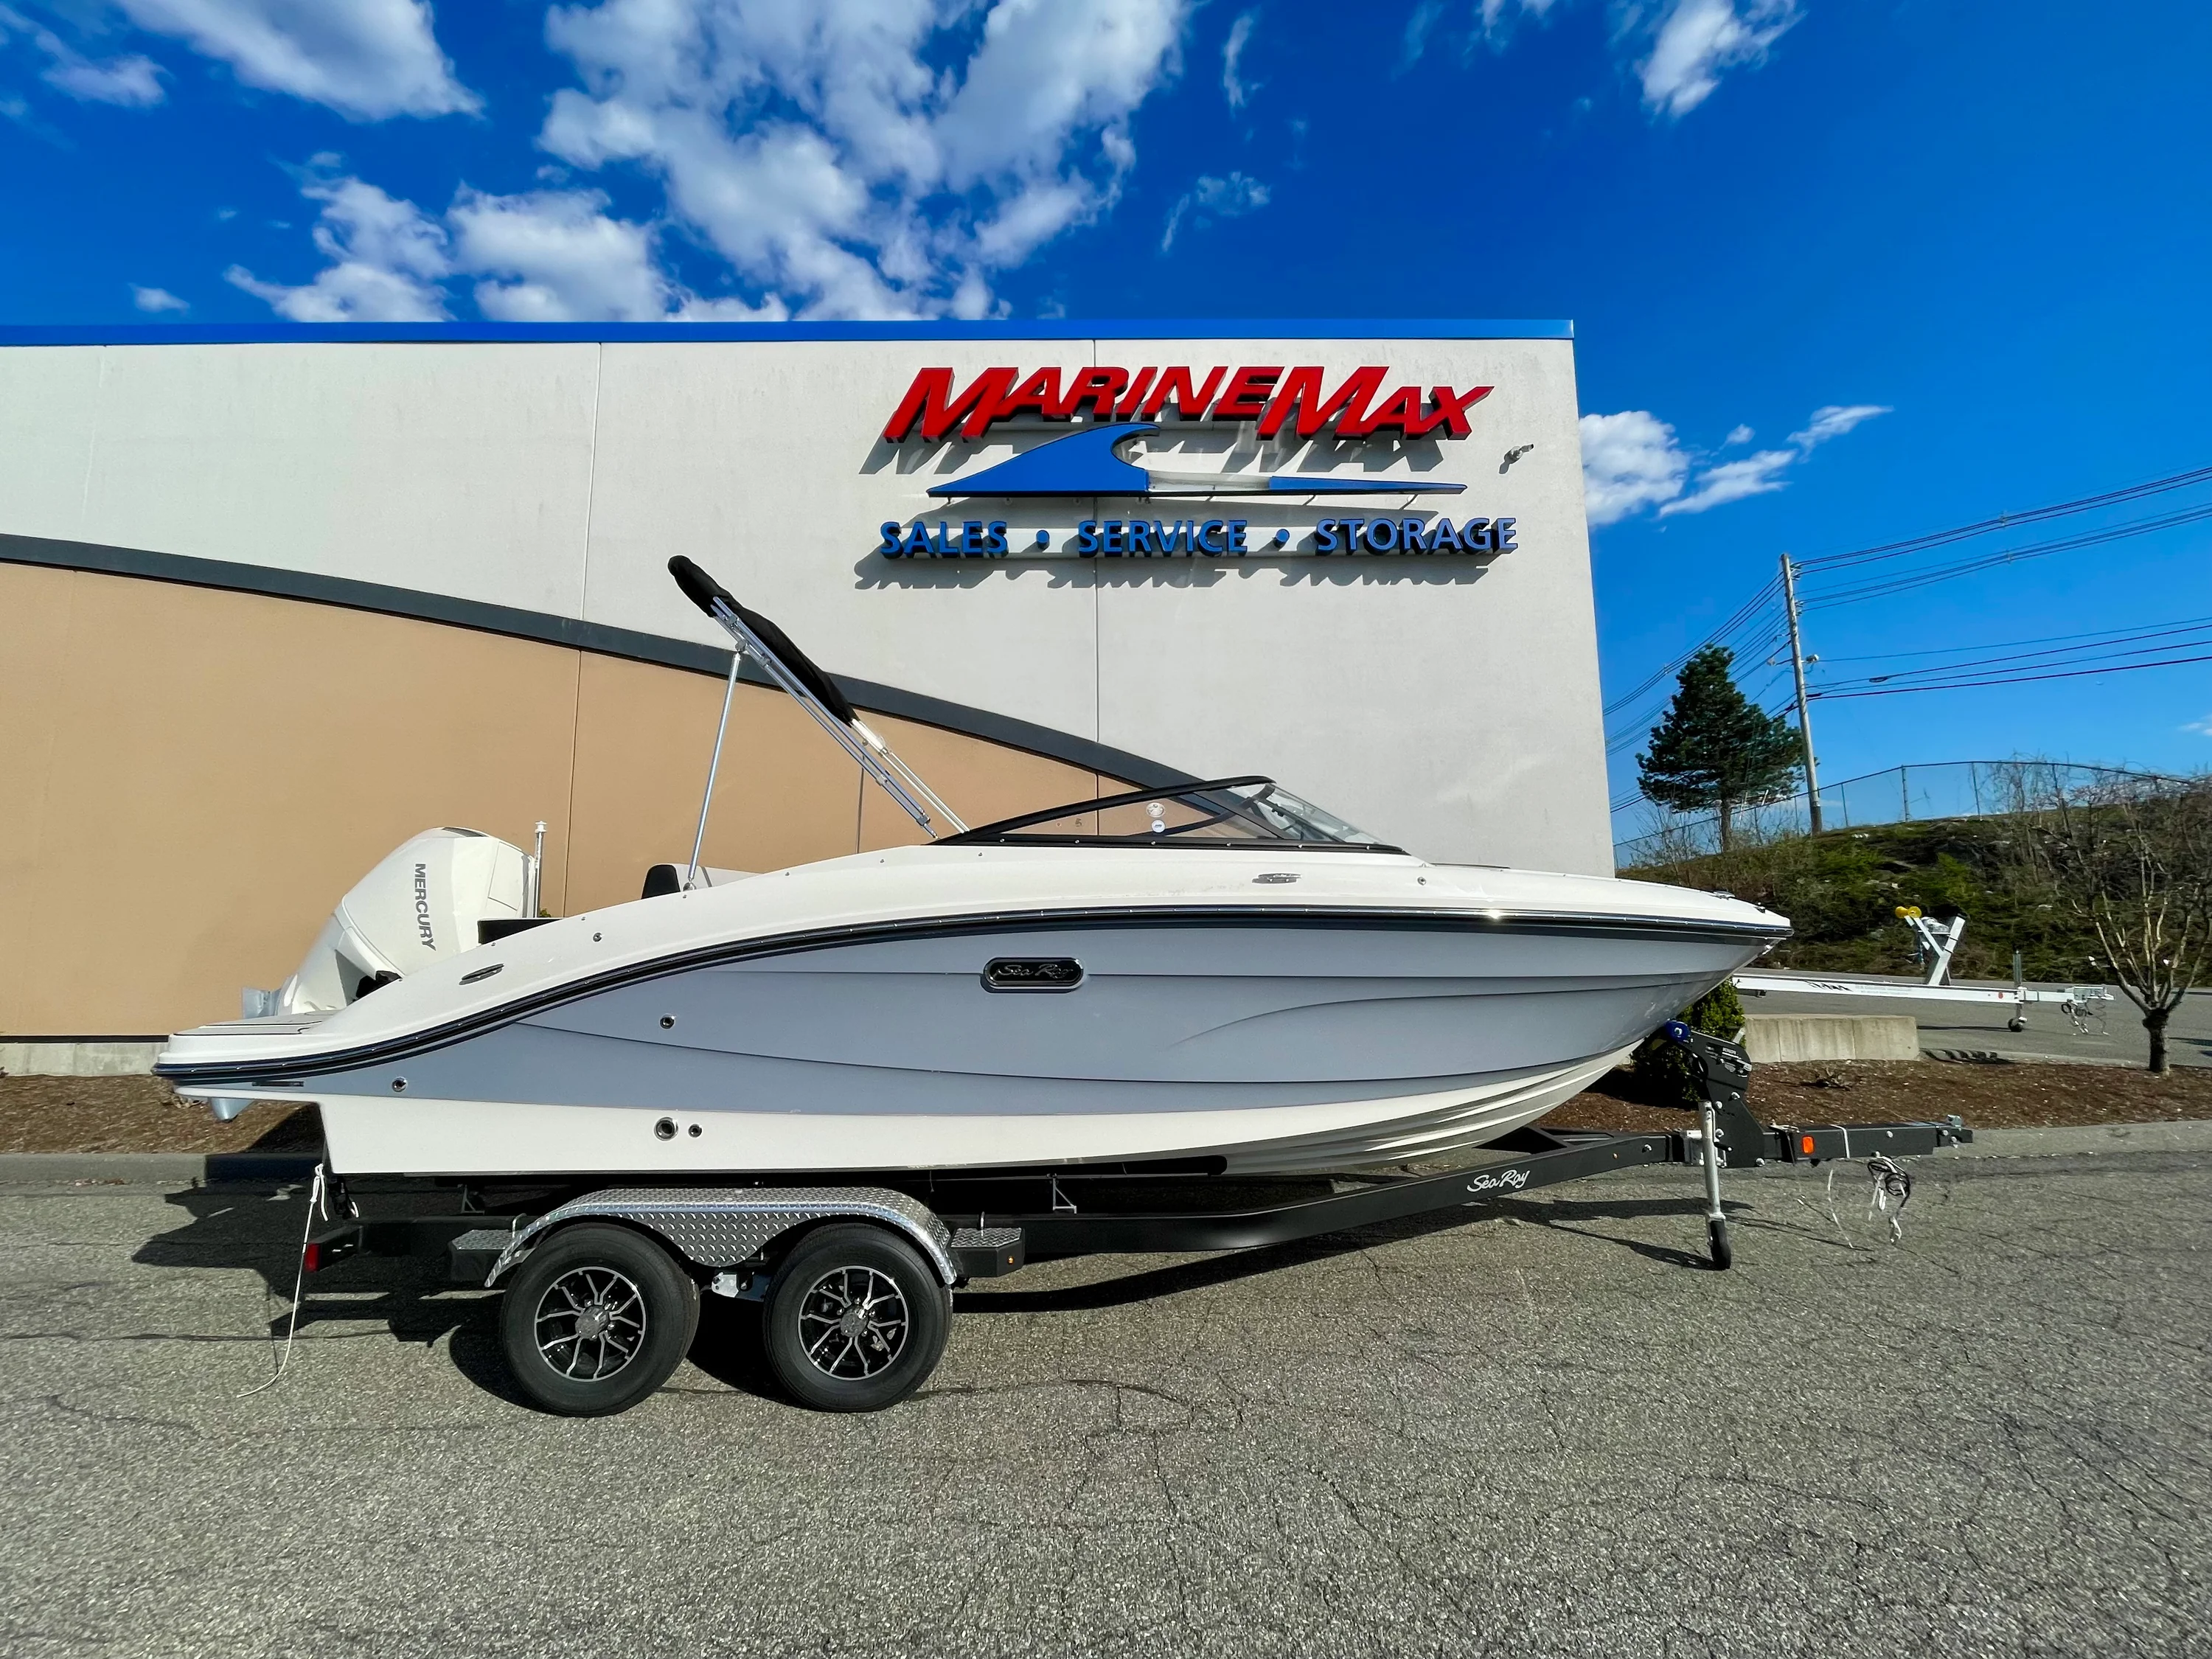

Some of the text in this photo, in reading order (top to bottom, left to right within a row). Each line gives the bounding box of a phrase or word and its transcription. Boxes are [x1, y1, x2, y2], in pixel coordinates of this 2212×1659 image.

[880, 517, 1519, 559] SALES SERVICE STORAGE
[414, 863, 437, 952] MERCURY
[995, 964, 1034, 977] Sea
